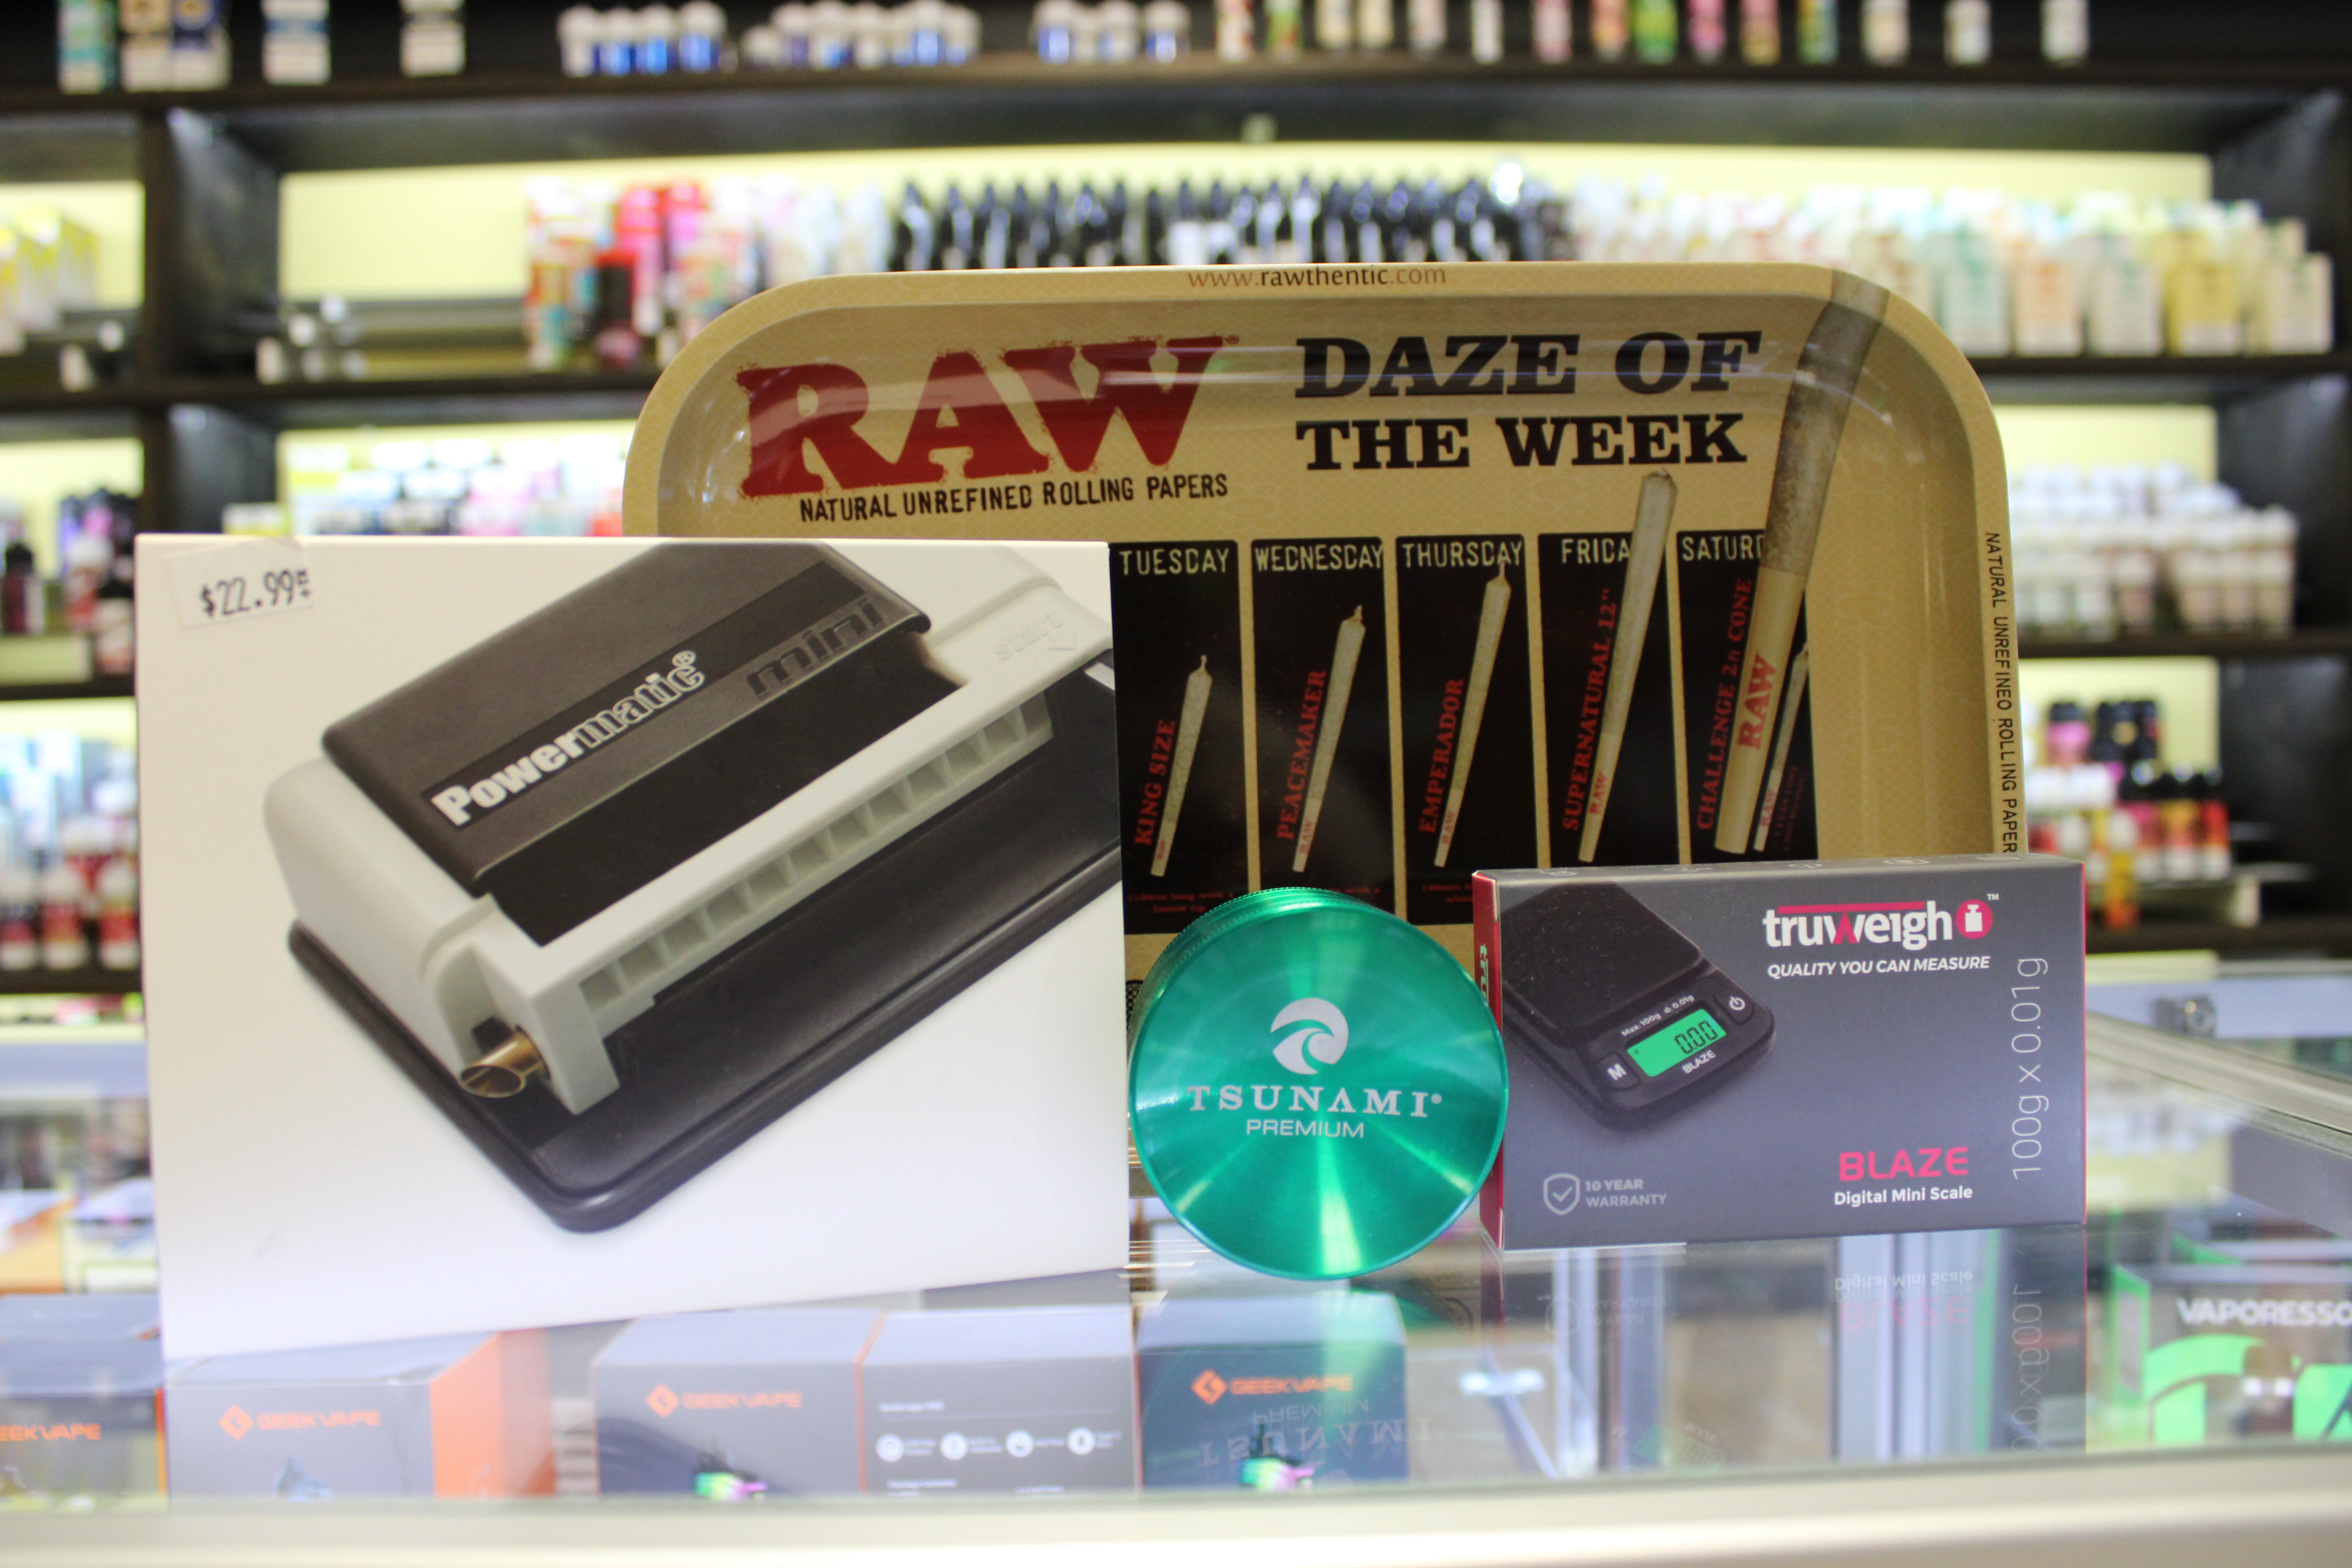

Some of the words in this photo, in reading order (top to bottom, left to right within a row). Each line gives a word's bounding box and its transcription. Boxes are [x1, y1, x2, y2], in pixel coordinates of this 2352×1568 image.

[1186, 265, 1446, 287] www.rawthentic.com
[1295, 333, 1580, 398] DAZE
[1615, 330, 1762, 394] OF
[1295, 417, 1470, 470] THE
[1496, 413, 1747, 467] WEEK
[800, 492, 897, 523] NATURAL
[904, 485, 1032, 516] UNREFINED
[1044, 477, 1134, 506] ROLLING
[1147, 473, 1229, 500] PAPERS
[1119, 548, 1230, 576] TUESDAY
[1255, 543, 1383, 572] WEDNESDAY
[1402, 540, 1523, 569] THURSDAY
[746, 597, 884, 697] mini
[1985, 532, 2006, 608] NATURAL
[1998, 718, 2017, 791] ROLLING
[1697, 682, 1736, 830] CHALLENGE
[1727, 577, 1753, 642] CONE
[1737, 652, 1777, 750] RAW
[1563, 637, 1610, 831] SUPERNATURAL
[1276, 670, 1326, 840] PEACEMAKER
[1419, 678, 1464, 833] EMPERADOR
[1134, 783, 1163, 846] KING
[1149, 719, 1176, 776] SIZE
[1589, 771, 1609, 815] RAW
[1762, 900, 1953, 951] truweigh
[1768, 962, 1837, 980] QUALITY
[1840, 960, 1874, 975] YOU
[1876, 959, 1911, 973] CAN
[1913, 955, 1991, 971] MEASURE
[1640, 1013, 1662, 1026] 100g
[2011, 957, 2048, 1054] 0.01g
[1674, 1020, 1718, 1054] 0.00
[1608, 1063, 1626, 1081] M
[1682, 1049, 1717, 1074] BLAZE
[2019, 1064, 2041, 1083] x
[1246, 1119, 1365, 1138] PREMIUM
[2012, 1094, 2049, 1180] 100g
[1838, 1146, 1969, 1181] BLAZE
[1585, 1180, 1601, 1192] 10
[1604, 1178, 1644, 1191] YEAR
[1585, 1193, 1667, 1208] WARRANTY
[1834, 1188, 1887, 1208] Digital
[1891, 1187, 1926, 1203] Mini
[1929, 1185, 1973, 1201] Scale
[2176, 1297, 2352, 1327] VAPORESSO
[1229, 1376, 1354, 1396] GEEKVAPE
